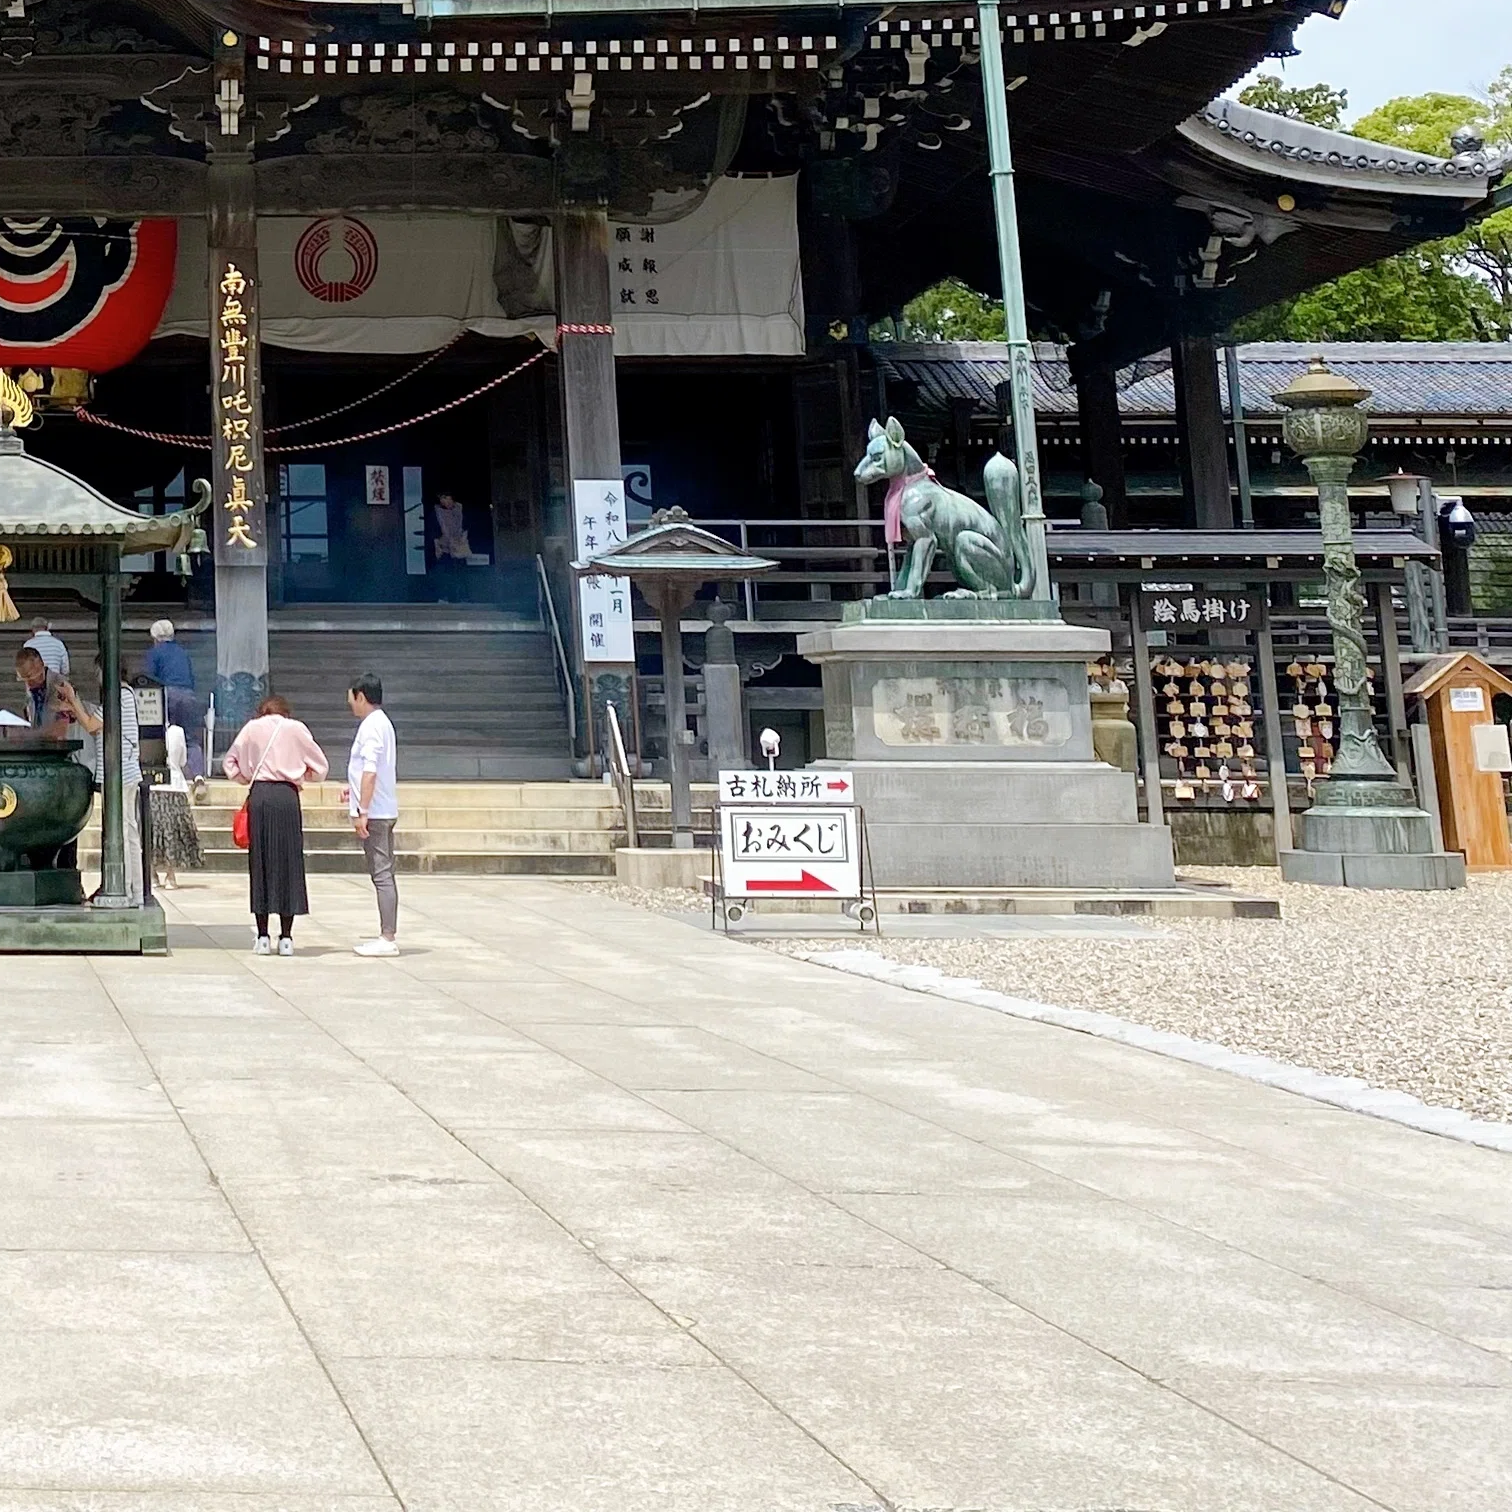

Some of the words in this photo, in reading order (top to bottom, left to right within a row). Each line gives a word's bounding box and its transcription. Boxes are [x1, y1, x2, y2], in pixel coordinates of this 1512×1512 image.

[603, 490, 622, 545] 令和八
[1152, 597, 1251, 624] 絵馬掛け
[588, 612, 606, 649] 開催
[726, 774, 823, 800] 古札納所
[741, 820, 839, 855] おみくじ
